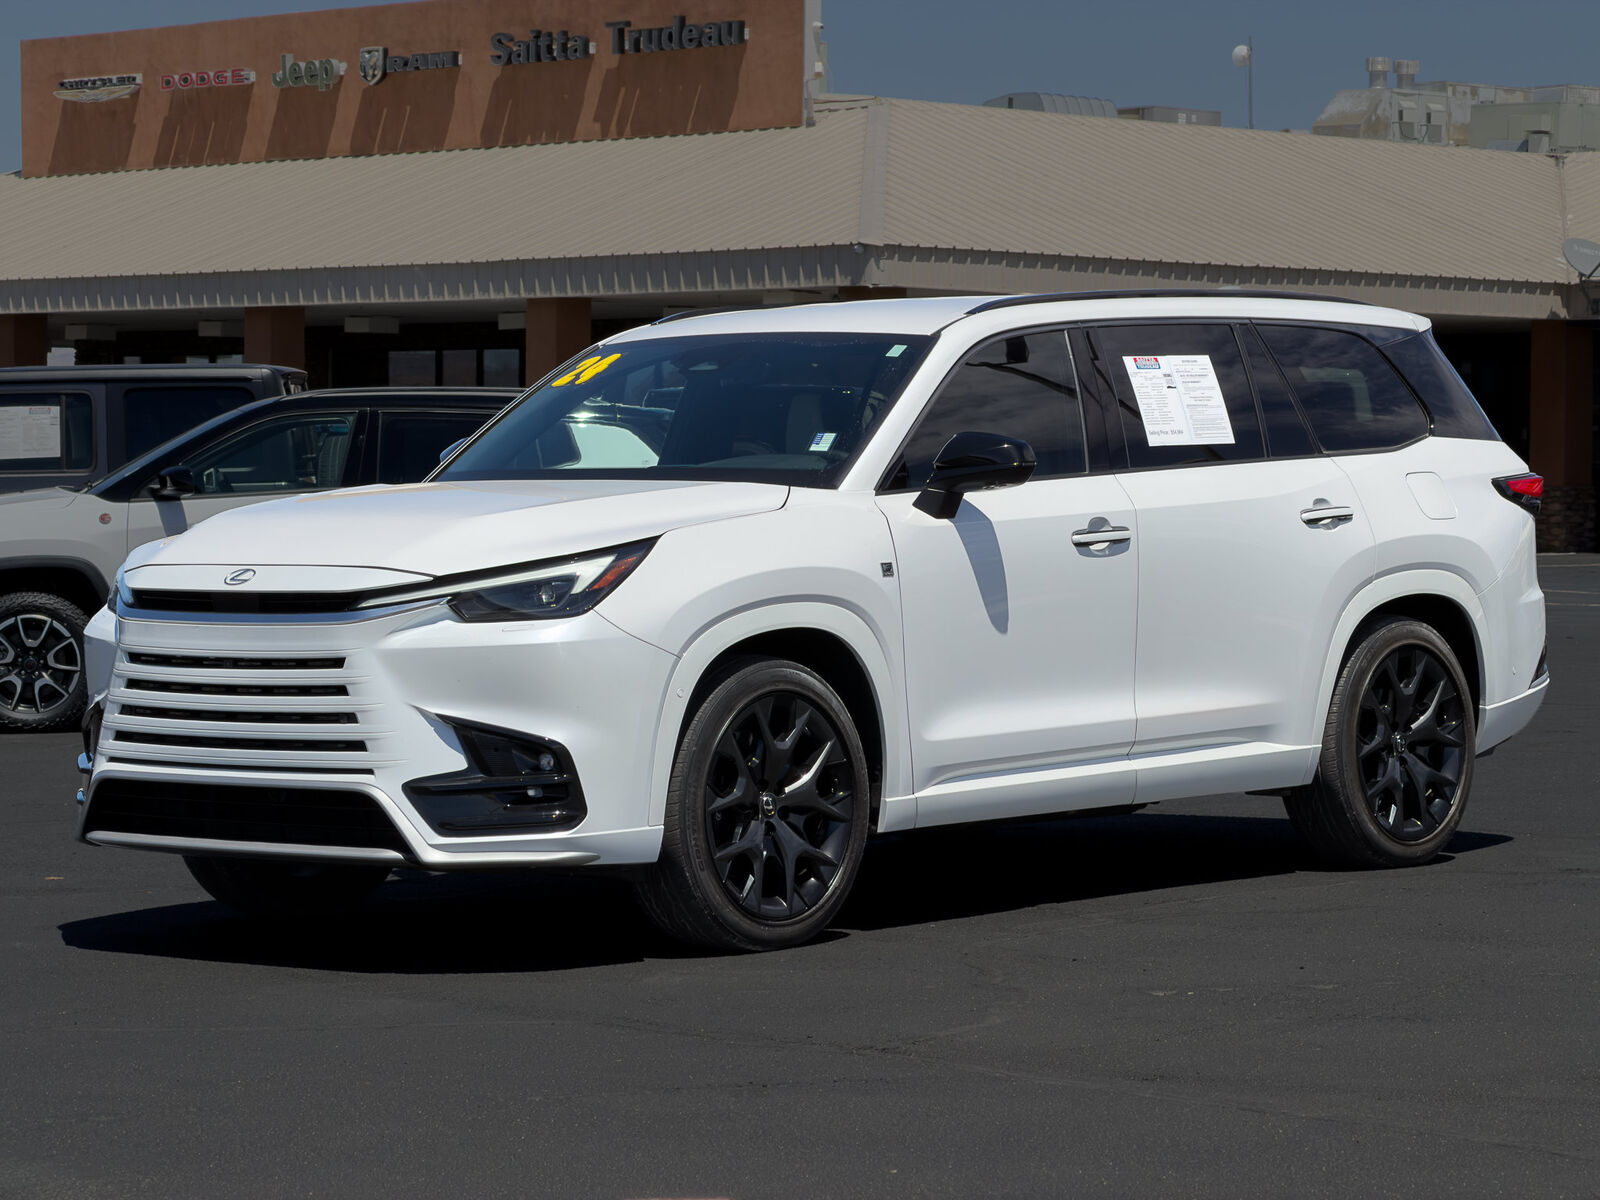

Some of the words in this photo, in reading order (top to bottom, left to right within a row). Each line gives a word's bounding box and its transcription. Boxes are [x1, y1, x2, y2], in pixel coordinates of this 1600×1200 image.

[490, 29, 592, 66] Saitta
[605, 15, 748, 55] Trudeau
[272, 53, 341, 91] Jeep
[386, 51, 459, 72] RAM
[160, 68, 252, 91] DODGE
